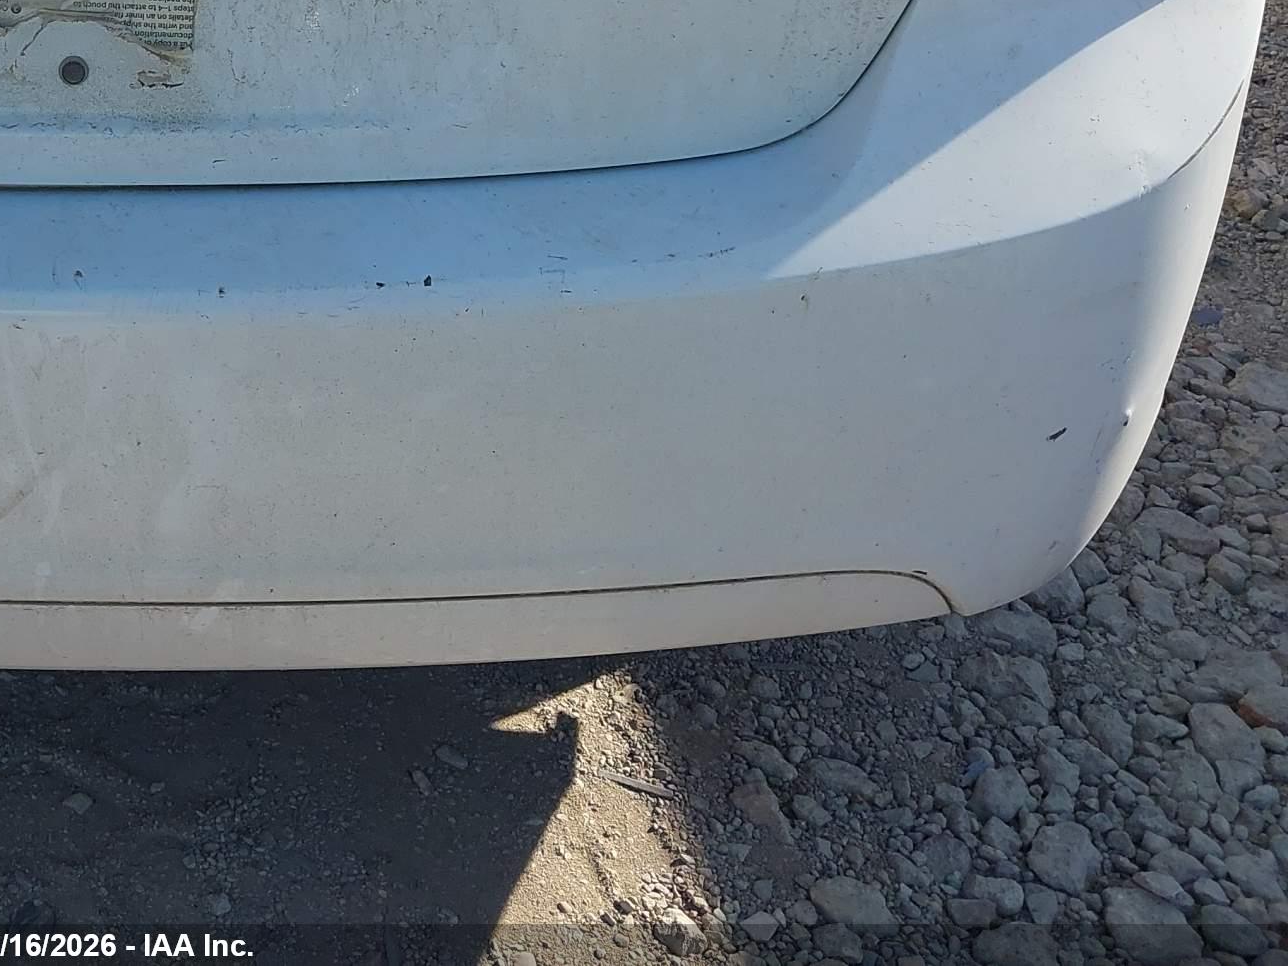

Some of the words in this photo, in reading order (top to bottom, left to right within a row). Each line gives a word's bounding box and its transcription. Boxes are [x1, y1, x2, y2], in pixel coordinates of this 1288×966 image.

[82, 0, 107, 9] pouch
[121, 2, 146, 10] attach
[174, 3, 194, 13] steps
[124, 12, 144, 20] inner
[168, 13, 194, 22] details
[157, 22, 178, 30] write
[134, 30, 194, 40] documentation
